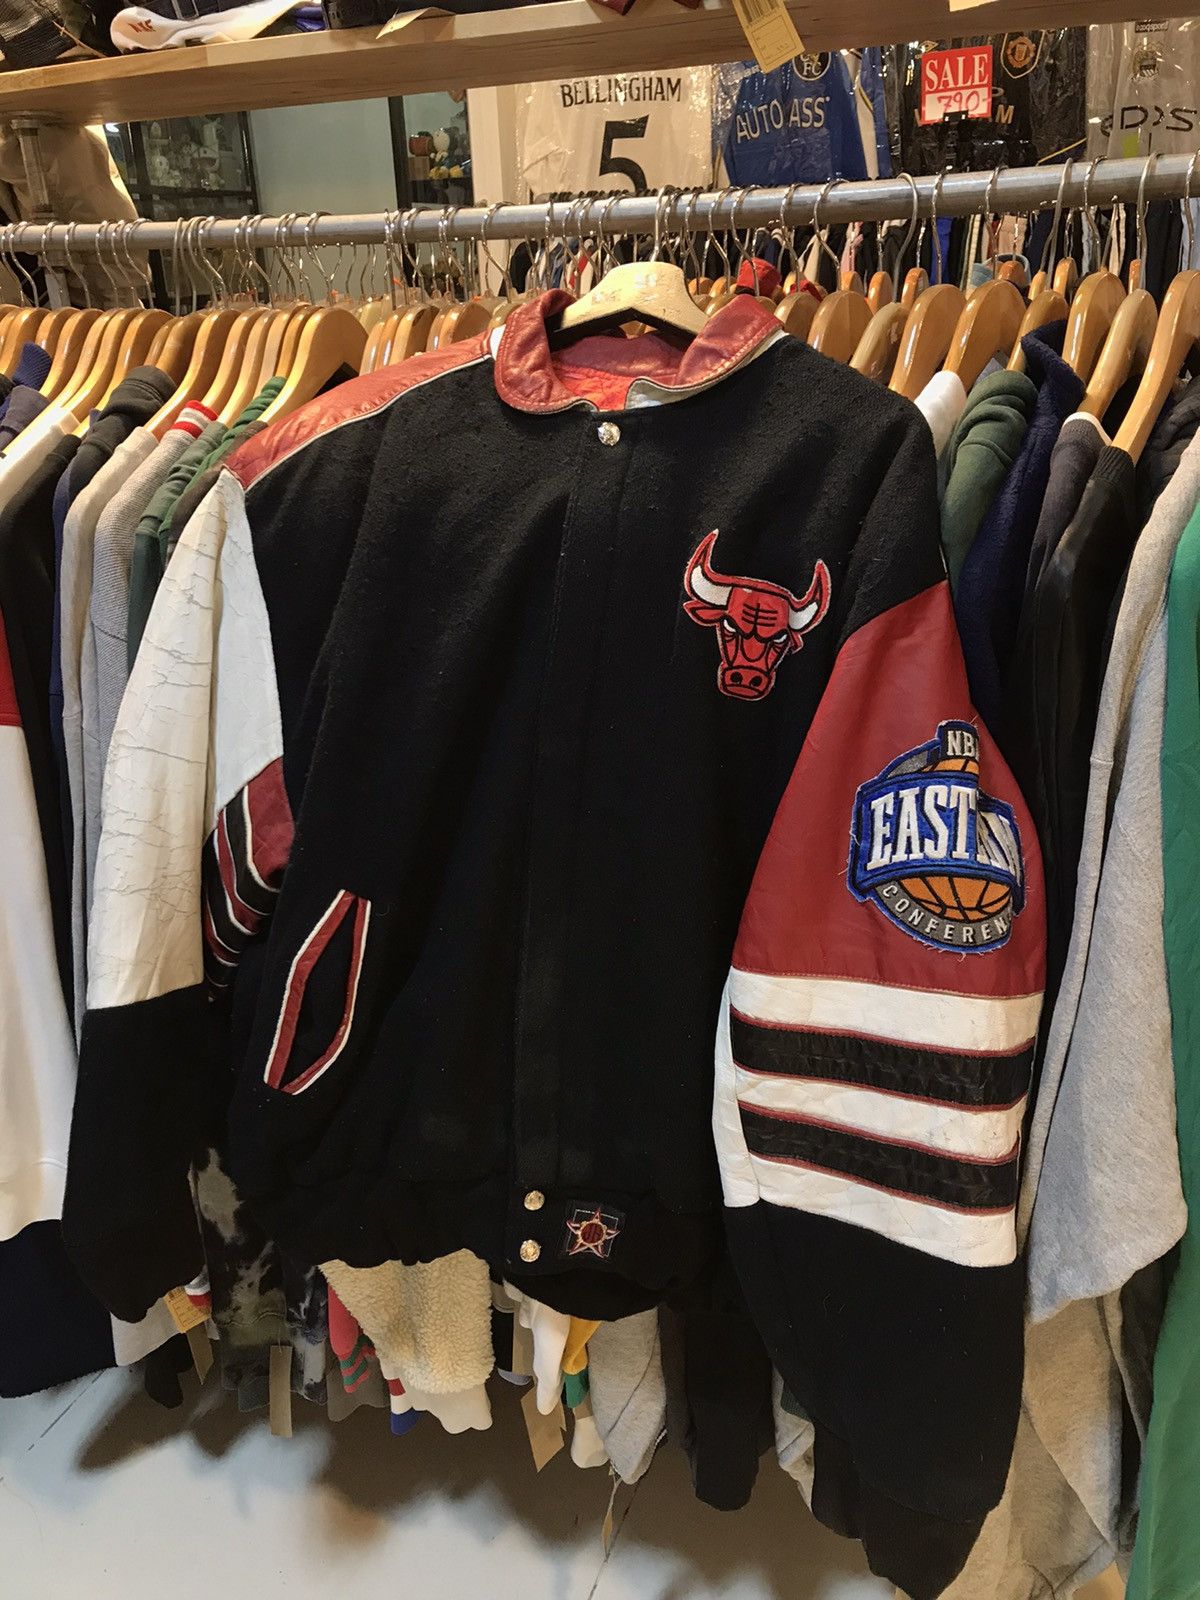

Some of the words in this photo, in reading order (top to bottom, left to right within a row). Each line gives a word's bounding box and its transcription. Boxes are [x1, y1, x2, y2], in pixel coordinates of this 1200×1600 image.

[925, 54, 988, 92] SALE
[560, 77, 681, 108] BELLINGHAM
[599, 114, 649, 193] 5
[946, 730, 979, 760] NB
[882, 884, 1011, 942] CONFEREN
